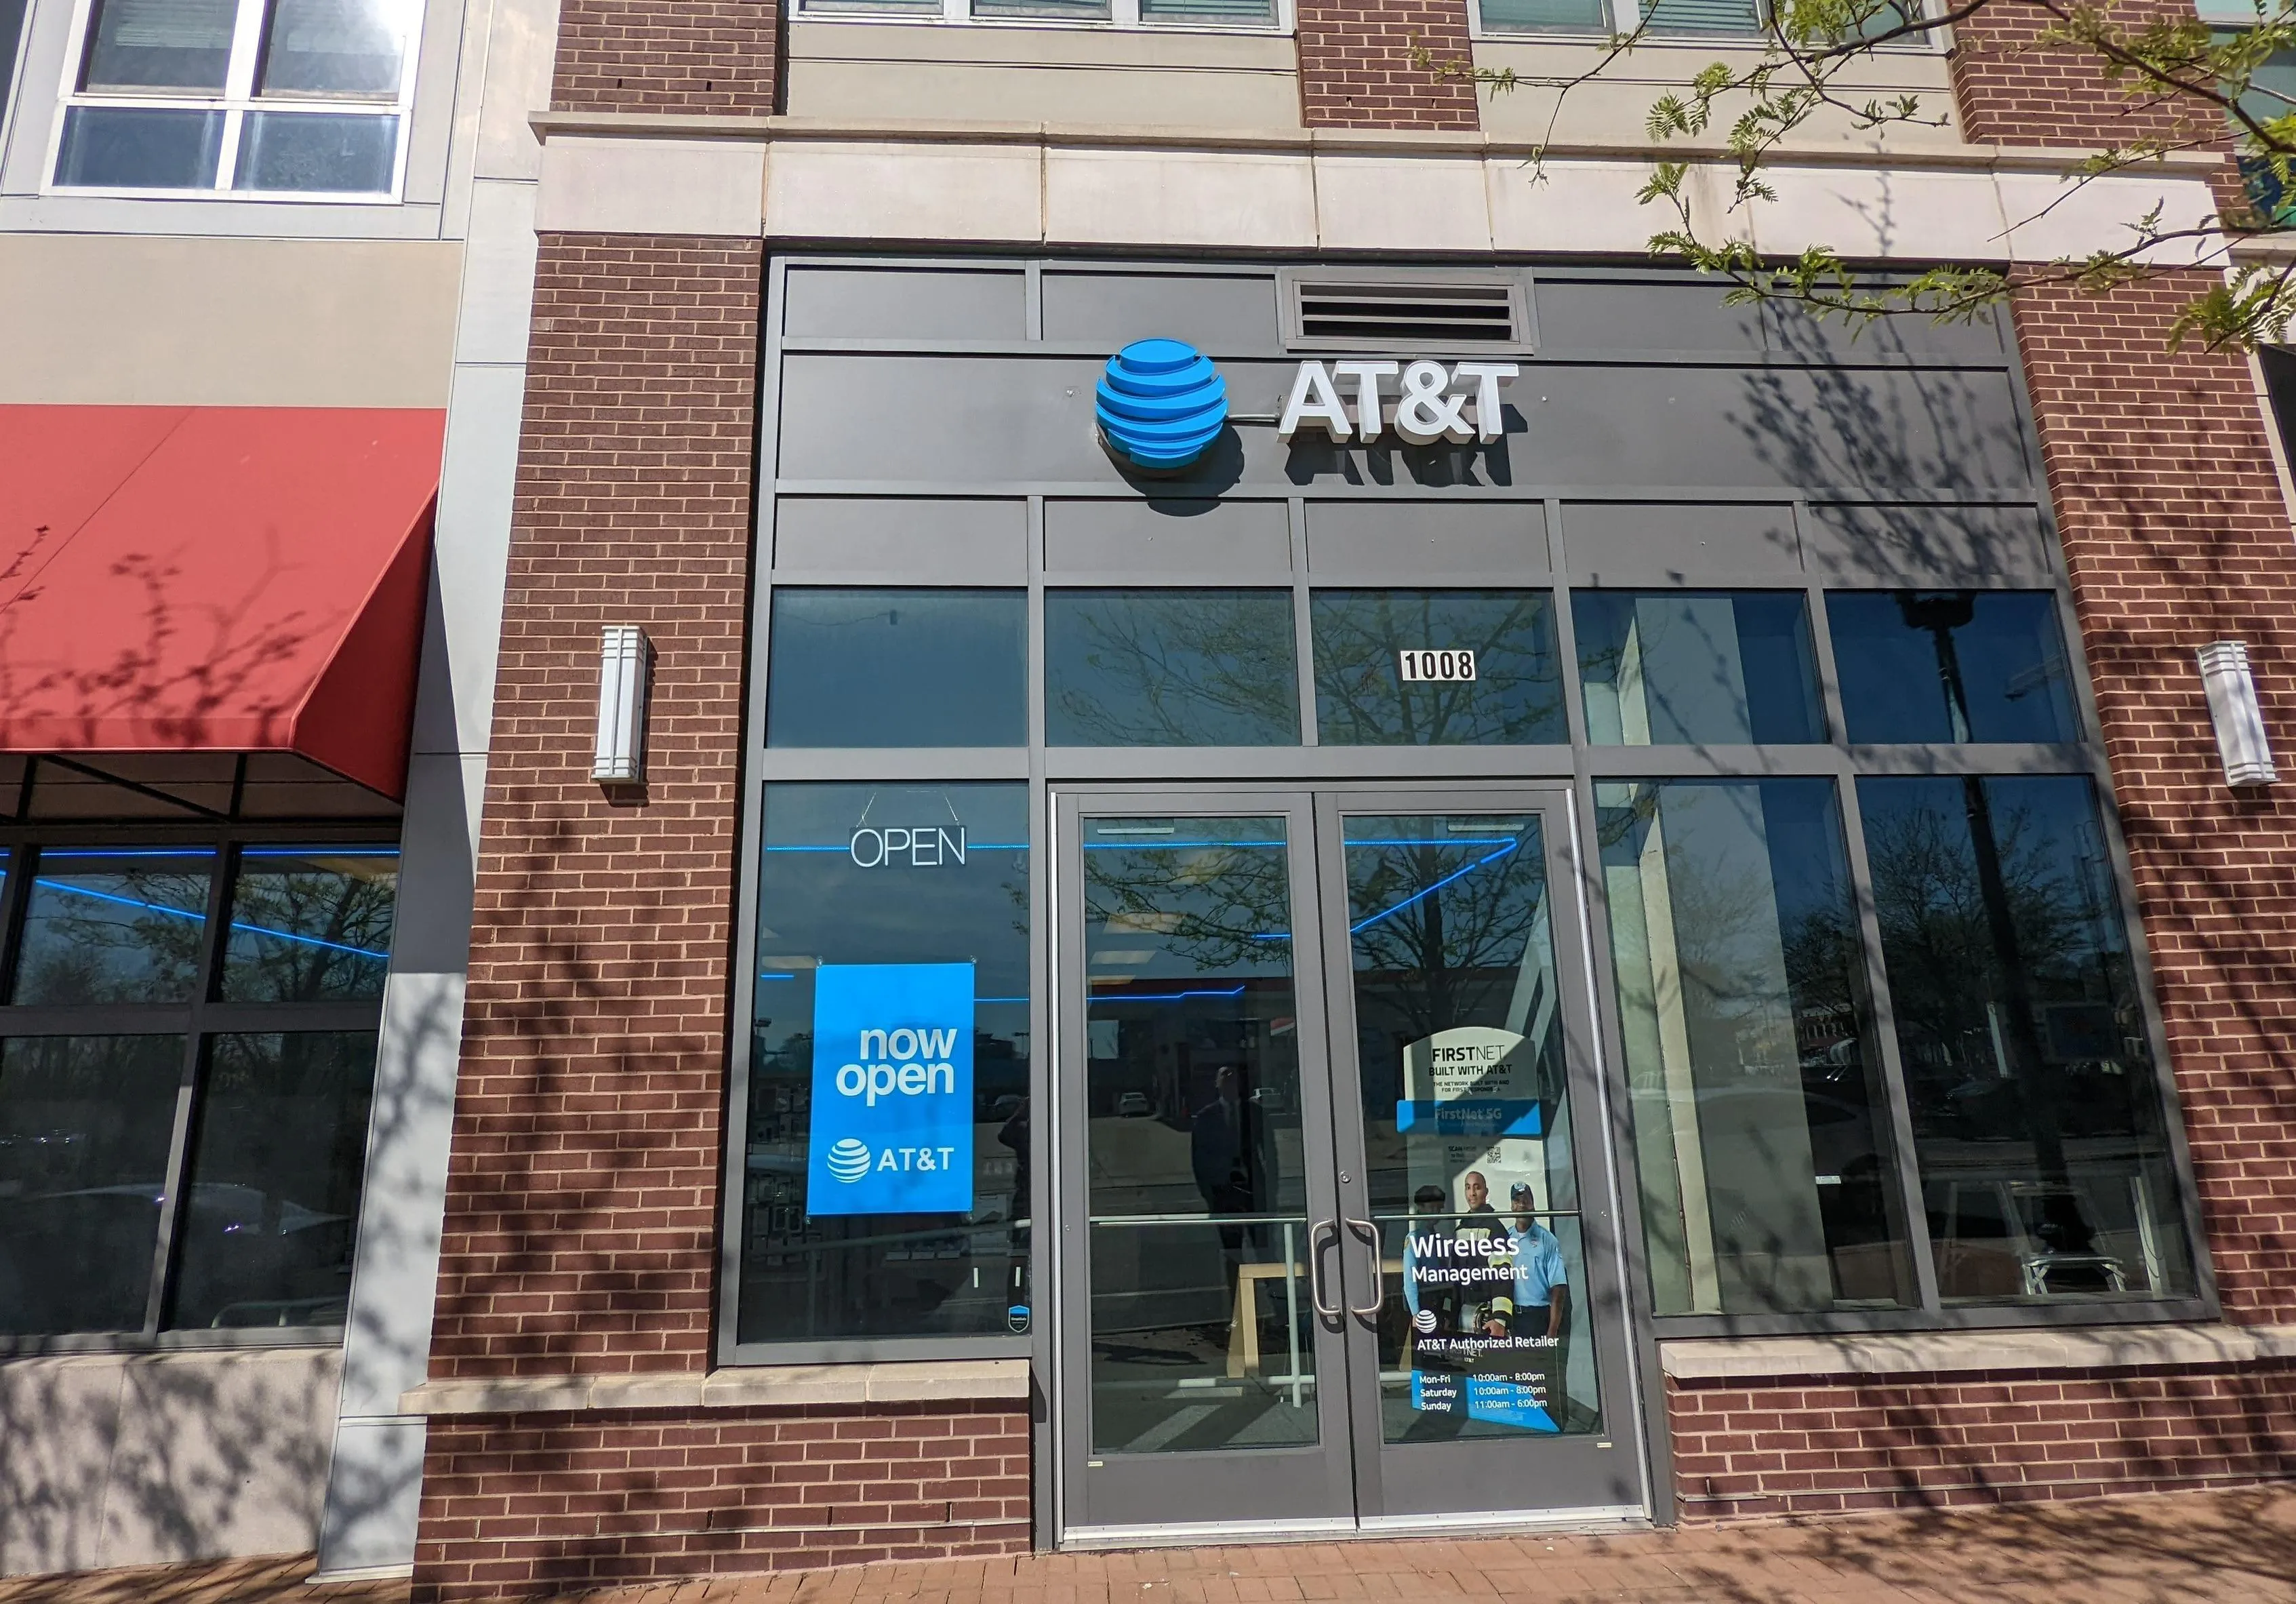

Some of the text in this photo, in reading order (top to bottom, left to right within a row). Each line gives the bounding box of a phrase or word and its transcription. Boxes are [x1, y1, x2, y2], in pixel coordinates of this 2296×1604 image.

[1277, 360, 1518, 445] AT&T
[1405, 652, 1472, 679] 1008
[850, 828, 966, 868] OPEN
[860, 1028, 958, 1060] now
[1432, 1045, 1505, 1062] FIRSTNET
[1429, 1064, 1512, 1077] BUILT WITH AT&T
[836, 1062, 954, 1106] open
[1487, 1108, 1502, 1120] 5G
[877, 1147, 954, 1172] AT&T
[1409, 1232, 1520, 1258] Wireless
[1412, 1264, 1529, 1285] Management
[1417, 1335, 1559, 1350] AT&T Authorized Retailer
[1419, 1375, 1451, 1384] Mon-Fri
[1472, 1374, 1508, 1382] 10:00am
[1514, 1372, 1545, 1382] 8:00pm
[1420, 1388, 1457, 1399] Saturday
[1474, 1387, 1509, 1396] 10:00am
[1516, 1386, 1546, 1396] 8:00pm
[1421, 1401, 1451, 1412] Sunday
[1474, 1400, 1510, 1409] 11:00am
[1517, 1399, 1548, 1409] 6:00pm
